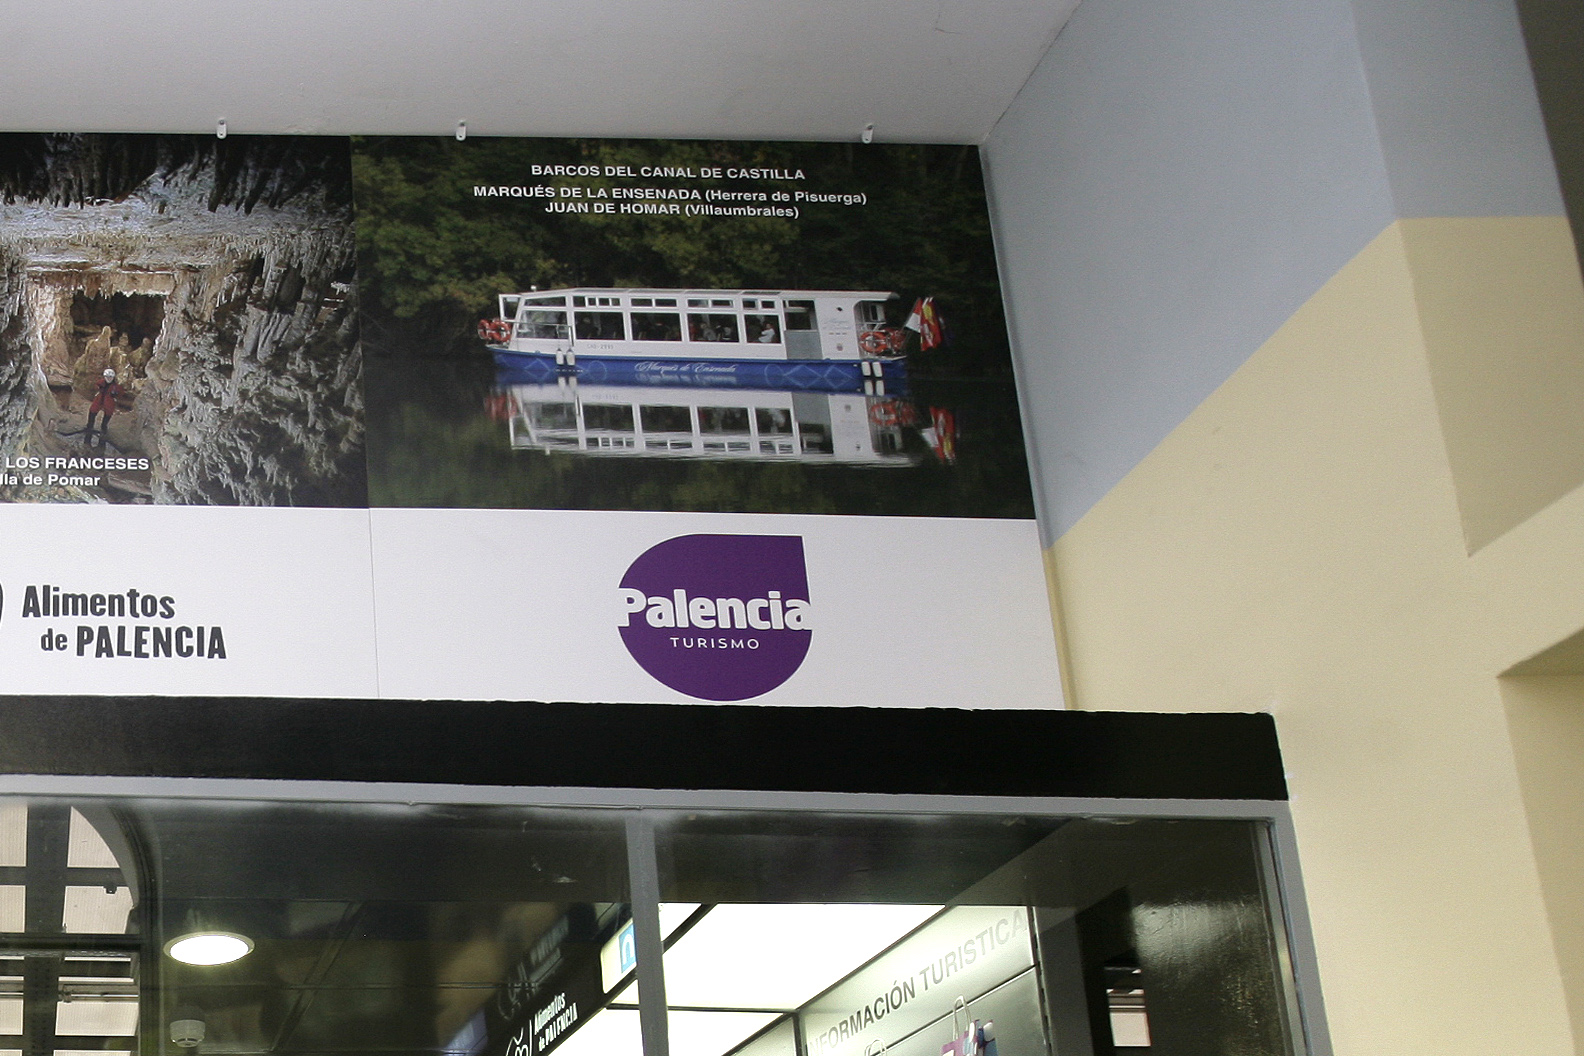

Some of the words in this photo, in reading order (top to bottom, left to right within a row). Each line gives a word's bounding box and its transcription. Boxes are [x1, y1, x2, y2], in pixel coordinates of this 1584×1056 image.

[531, 165, 600, 177] BARCOS
[604, 166, 637, 177] DEL
[640, 167, 697, 178] CANAL
[701, 167, 723, 179] DE
[726, 168, 806, 180] CASTILLA
[473, 184, 556, 198] MARQUÉS
[560, 187, 582, 198] DE
[586, 188, 608, 199] LA
[612, 188, 702, 200] ENSENADA
[705, 189, 767, 202] (Herrera
[771, 191, 791, 202] de
[795, 192, 867, 205] Pisuerga)
[545, 202, 589, 213] JUAN
[593, 203, 616, 214] DE
[620, 203, 680, 215] HOMAR
[685, 204, 799, 219] (Villaumbrales)
[6, 457, 40, 469] LOS
[45, 457, 149, 470] FRANCESES
[22, 474, 43, 486] de
[48, 474, 101, 487] Pomar
[22, 584, 176, 619] Alimentos
[617, 587, 812, 631] Palencia
[40, 628, 68, 651] de
[76, 625, 227, 659] PALENCIA
[670, 637, 760, 650] TURISMO
[919, 909, 1029, 991] TURISTICA
